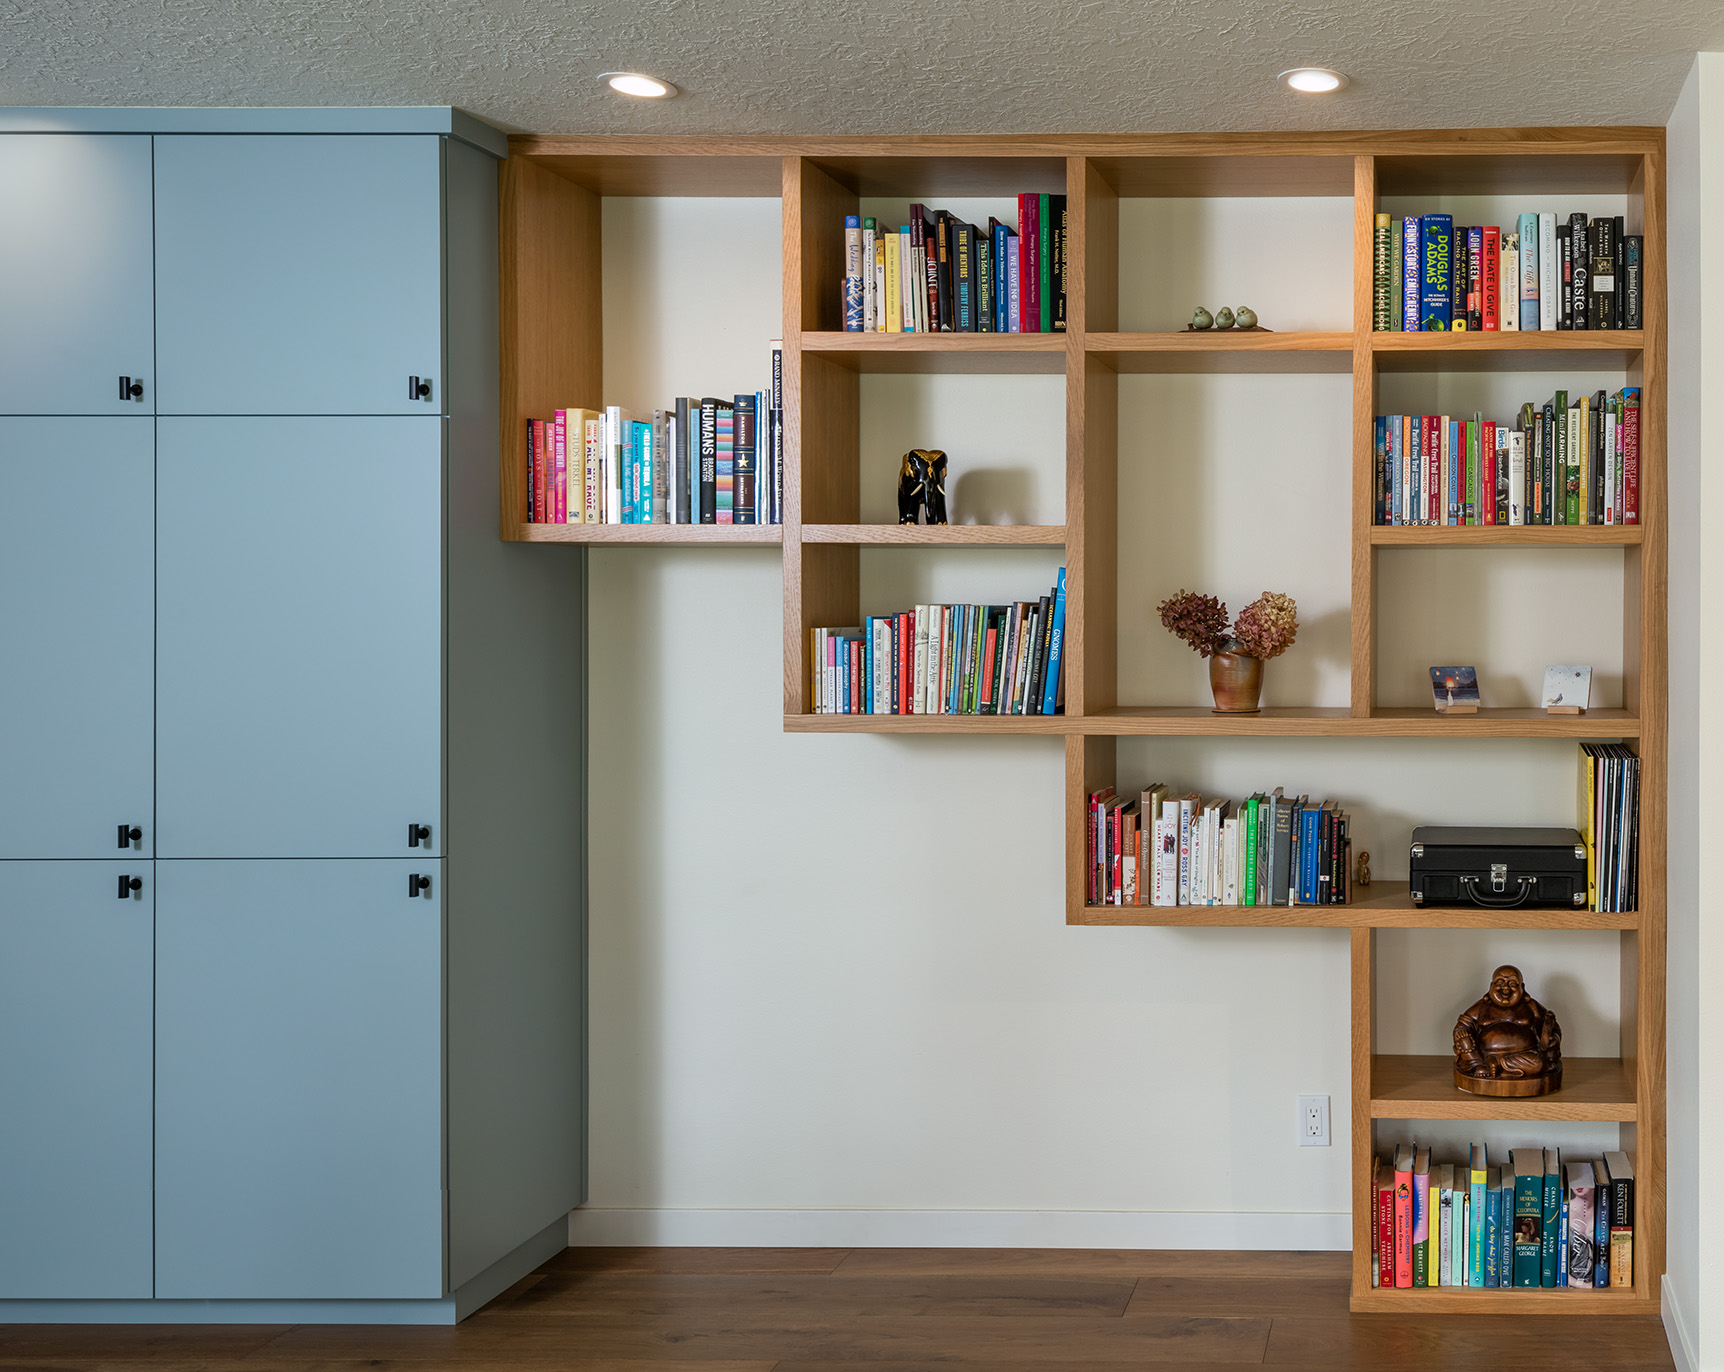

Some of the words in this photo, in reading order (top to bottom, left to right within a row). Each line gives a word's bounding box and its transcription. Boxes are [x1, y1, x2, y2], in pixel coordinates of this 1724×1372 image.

[959, 231, 967, 245] TRIBE
[1407, 225, 1417, 246] FUNNY
[1470, 233, 1479, 253] JOHN
[1394, 249, 1399, 259] WE
[1487, 238, 1495, 255] THE
[1525, 248, 1533, 262] The
[848, 244, 859, 272] Wedding
[960, 254, 968, 278] MENTORS
[1010, 255, 1016, 266] WE
[1407, 249, 1417, 270] STORY
[1427, 242, 1437, 283] ADAMS
[1437, 235, 1448, 291] DOUGLAS
[1471, 256, 1479, 280] GREEN
[927, 258, 937, 288] JOINT
[1487, 259, 1495, 281] HATE
[1523, 264, 1535, 285] Cliffs
[960, 282, 968, 305] TIMOTHY
[1010, 289, 1017, 300] NO
[1407, 278, 1417, 297] EMILY
[1461, 280, 1466, 289] OF
[1574, 268, 1587, 310] Caste
[1407, 300, 1417, 320] HENRY
[556, 416, 564, 424] THE
[556, 425, 564, 433] JOY
[702, 404, 714, 455] HUMANS
[556, 442, 564, 468] MOVEMENT
[572, 433, 580, 457] STUDS
[587, 447, 595, 463] ALL
[587, 468, 595, 481] MY
[587, 485, 595, 510] RAGE
[930, 641, 938, 656] Light
[1051, 629, 1060, 661] GNOMES
[930, 662, 938, 671] the
[929, 671, 937, 685] Attic
[1543, 1231, 1547, 1239] MY
